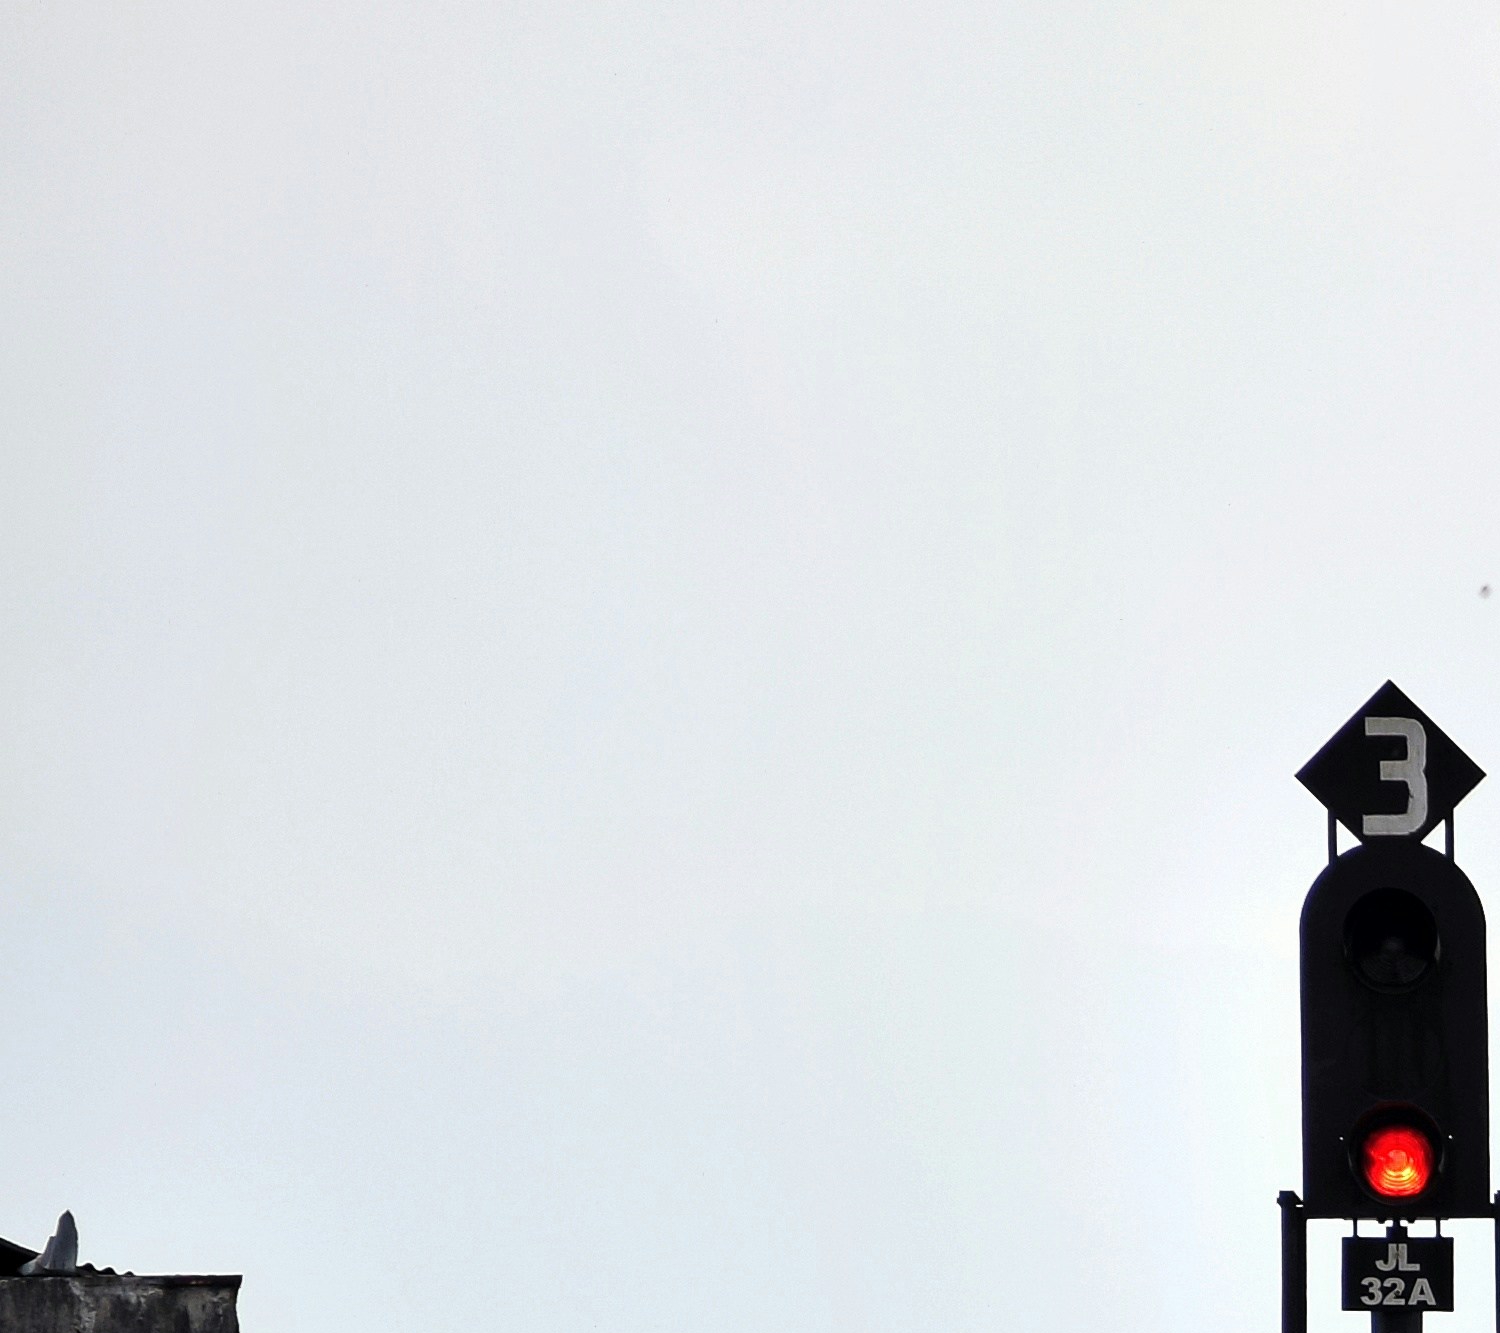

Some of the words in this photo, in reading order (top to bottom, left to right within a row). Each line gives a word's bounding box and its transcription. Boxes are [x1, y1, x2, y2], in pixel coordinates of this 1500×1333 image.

[1363, 717, 1428, 835] 3
[1375, 1243, 1420, 1271] JL
[1360, 1277, 1437, 1306] 32A
